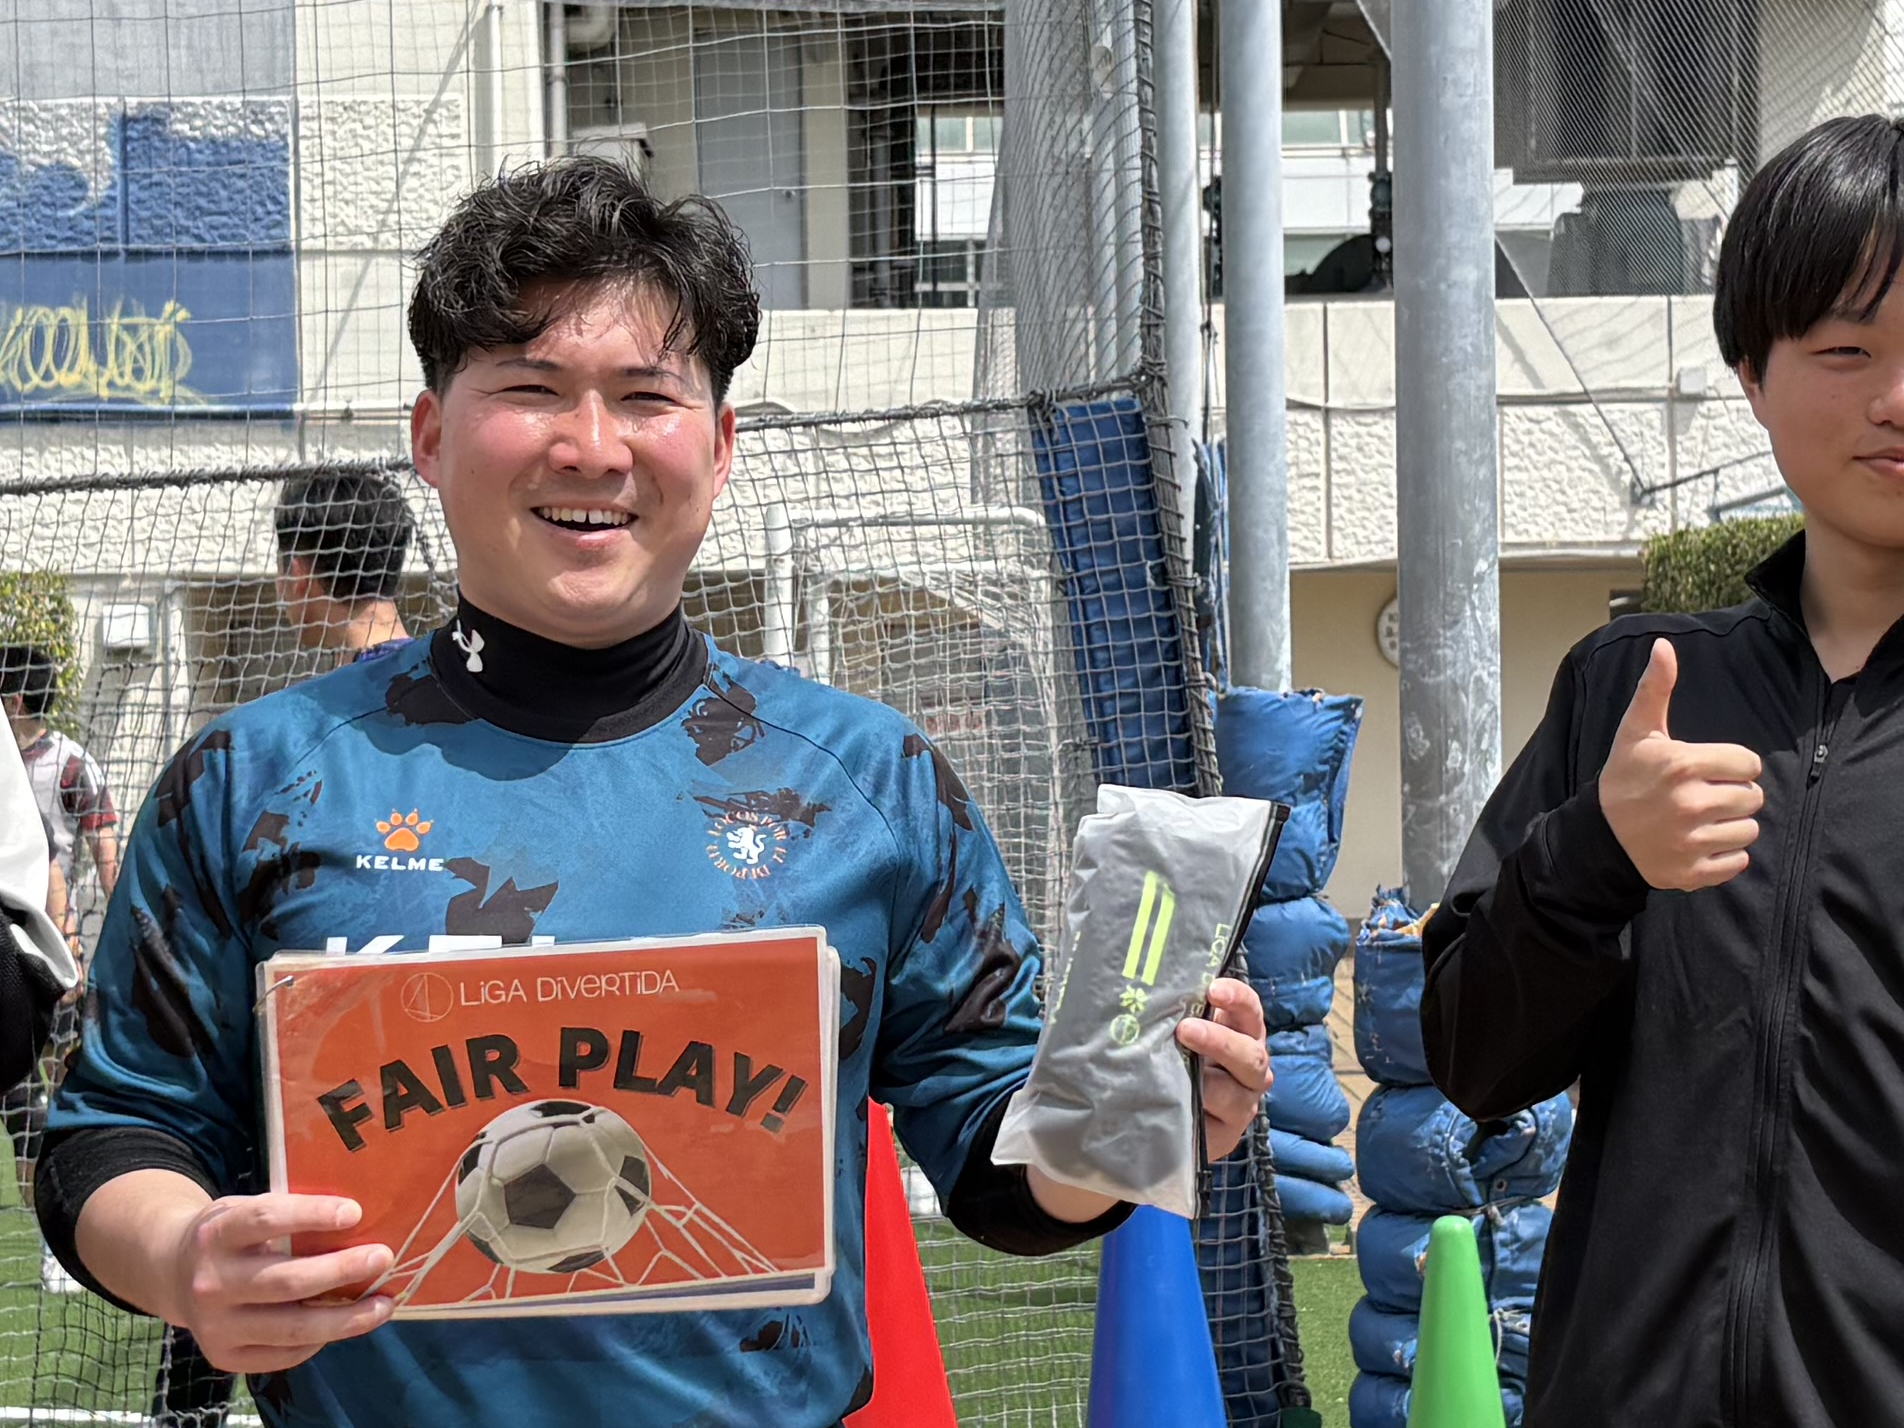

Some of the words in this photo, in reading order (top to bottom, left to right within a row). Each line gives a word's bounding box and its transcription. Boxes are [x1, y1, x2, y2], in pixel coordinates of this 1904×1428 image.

[356, 855, 444, 871] KELME
[316, 1033, 528, 1153] FAIR
[558, 1026, 808, 1134] PLAY!
